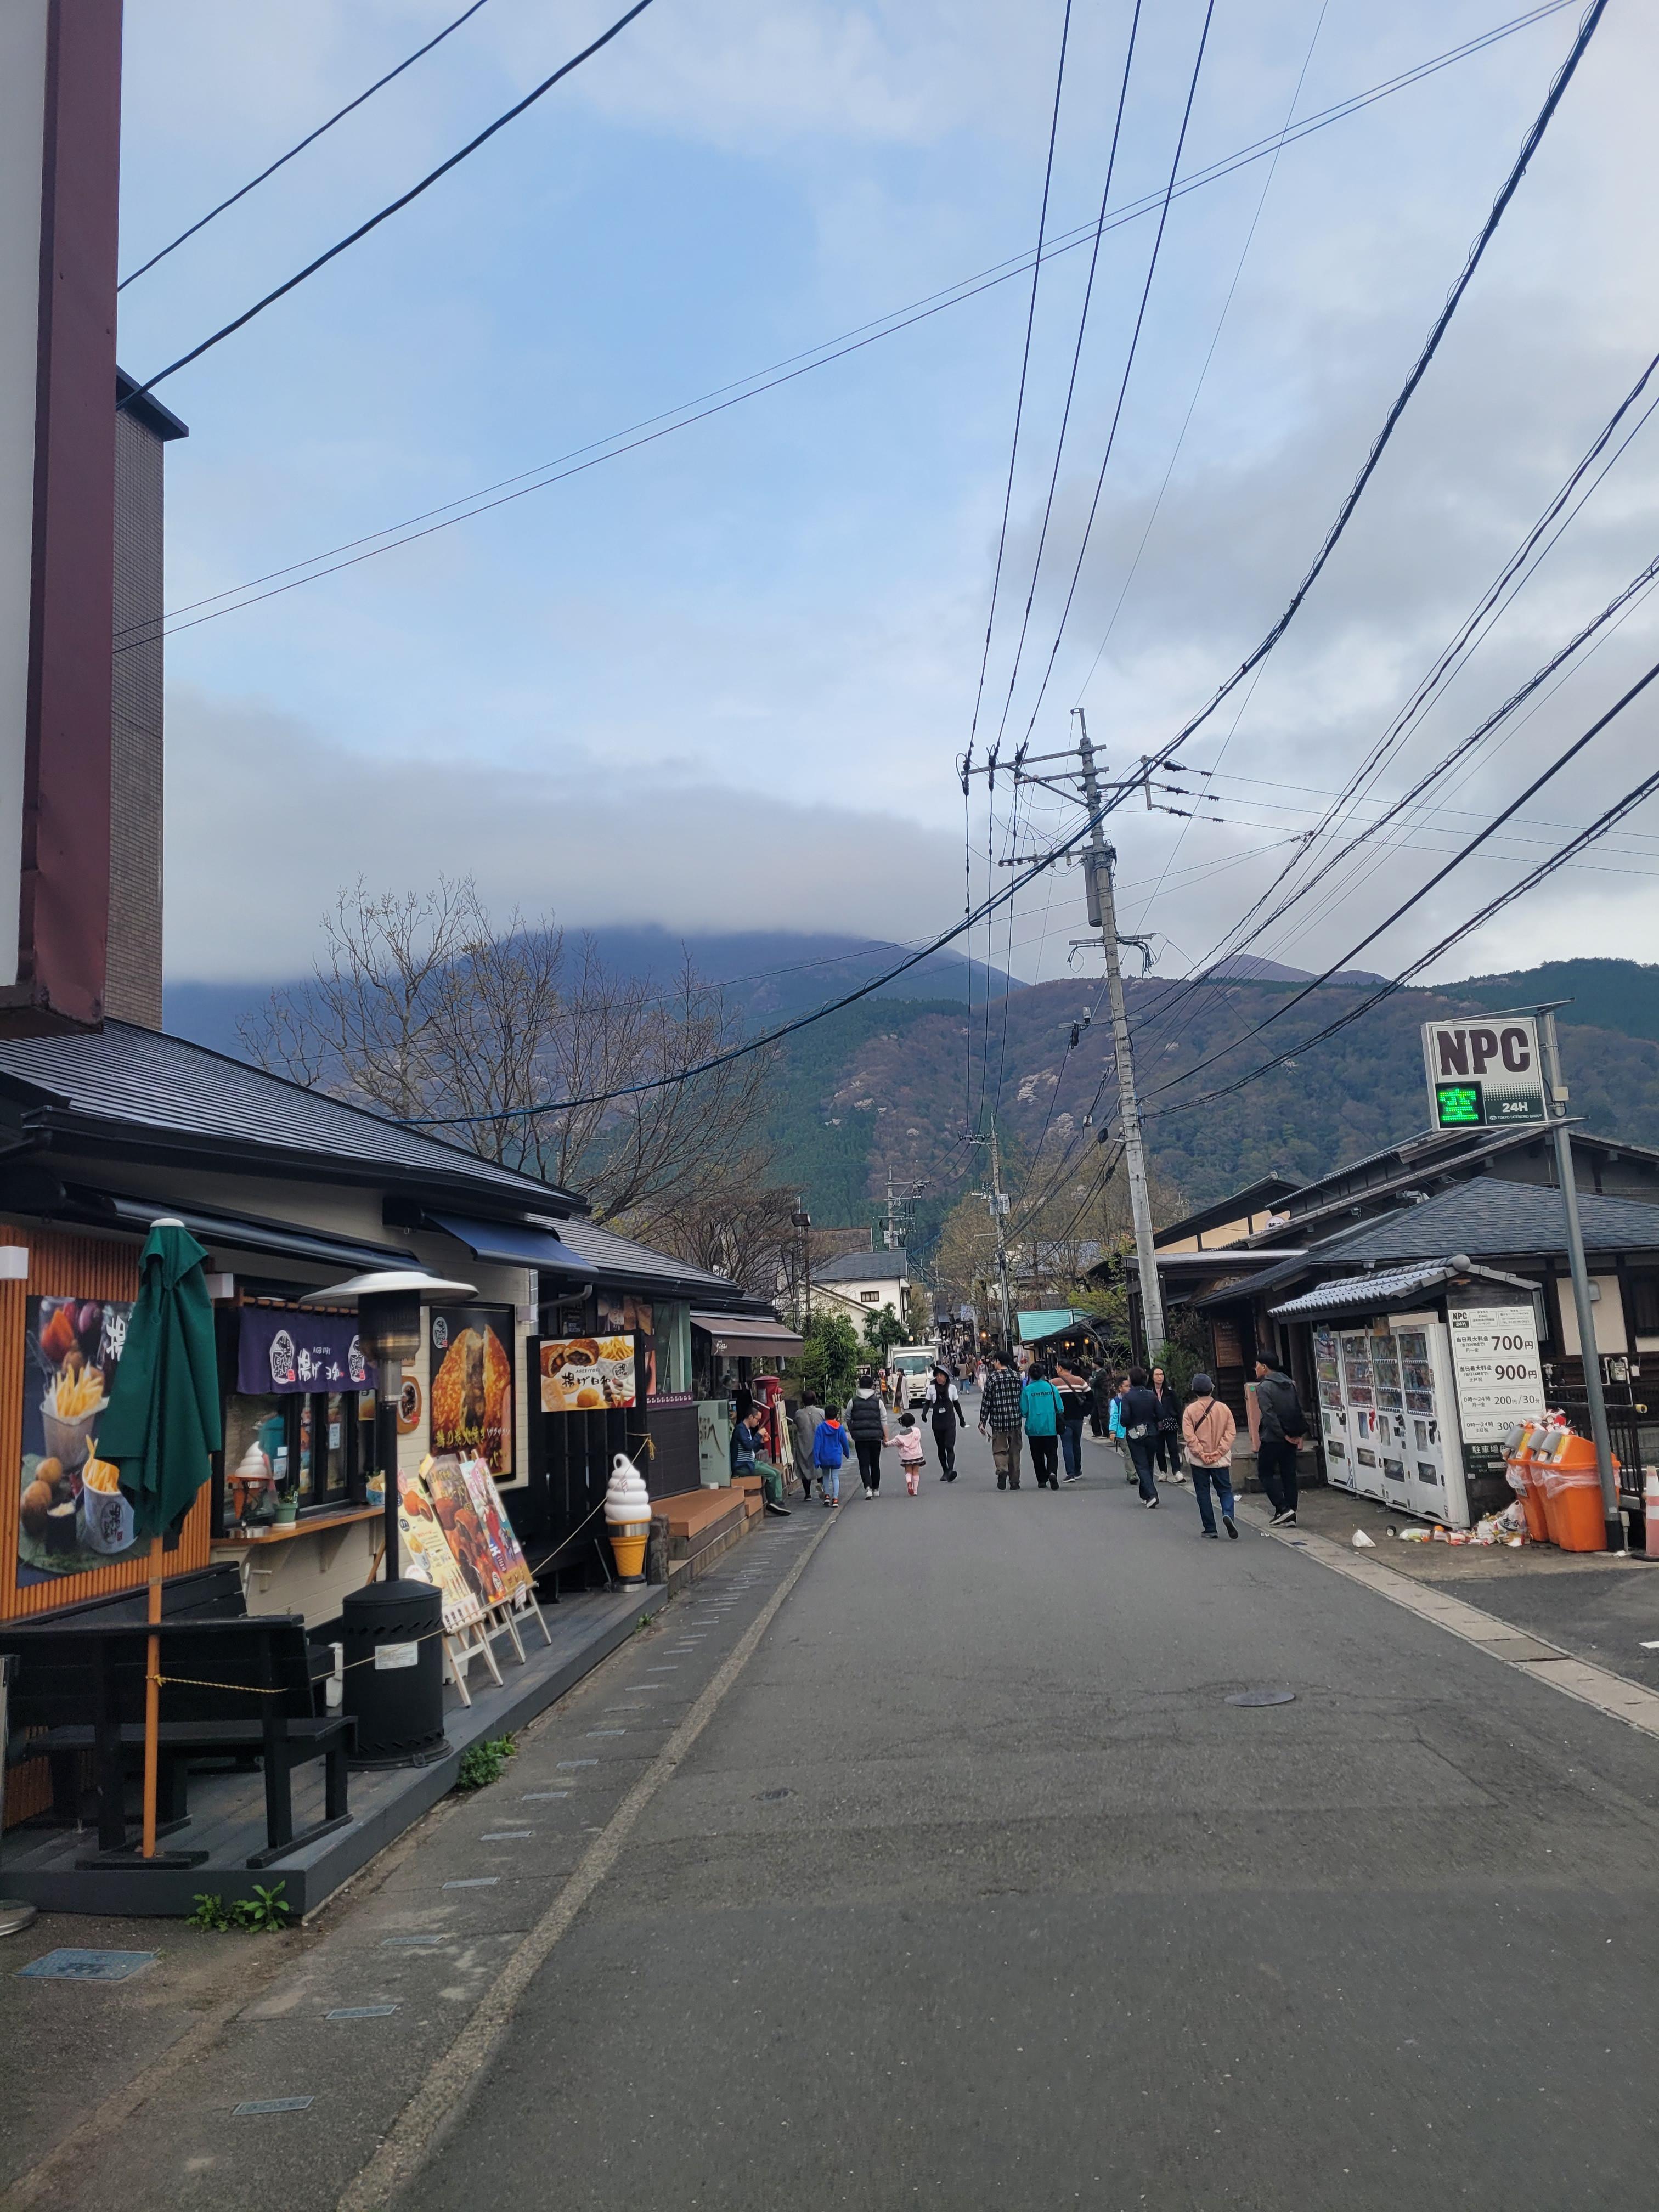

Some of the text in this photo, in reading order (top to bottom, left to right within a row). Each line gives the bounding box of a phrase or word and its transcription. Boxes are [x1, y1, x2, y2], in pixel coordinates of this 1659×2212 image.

[1436, 1027, 1531, 1076] NPC
[1438, 1088, 1479, 1122] 空
[1502, 1101, 1528, 1113] 24H
[1452, 1312, 1468, 1321] NPC
[1491, 1335, 1534, 1351] 700円
[561, 1371, 611, 1387] 揚げ日和
[1494, 1364, 1537, 1380] 900円
